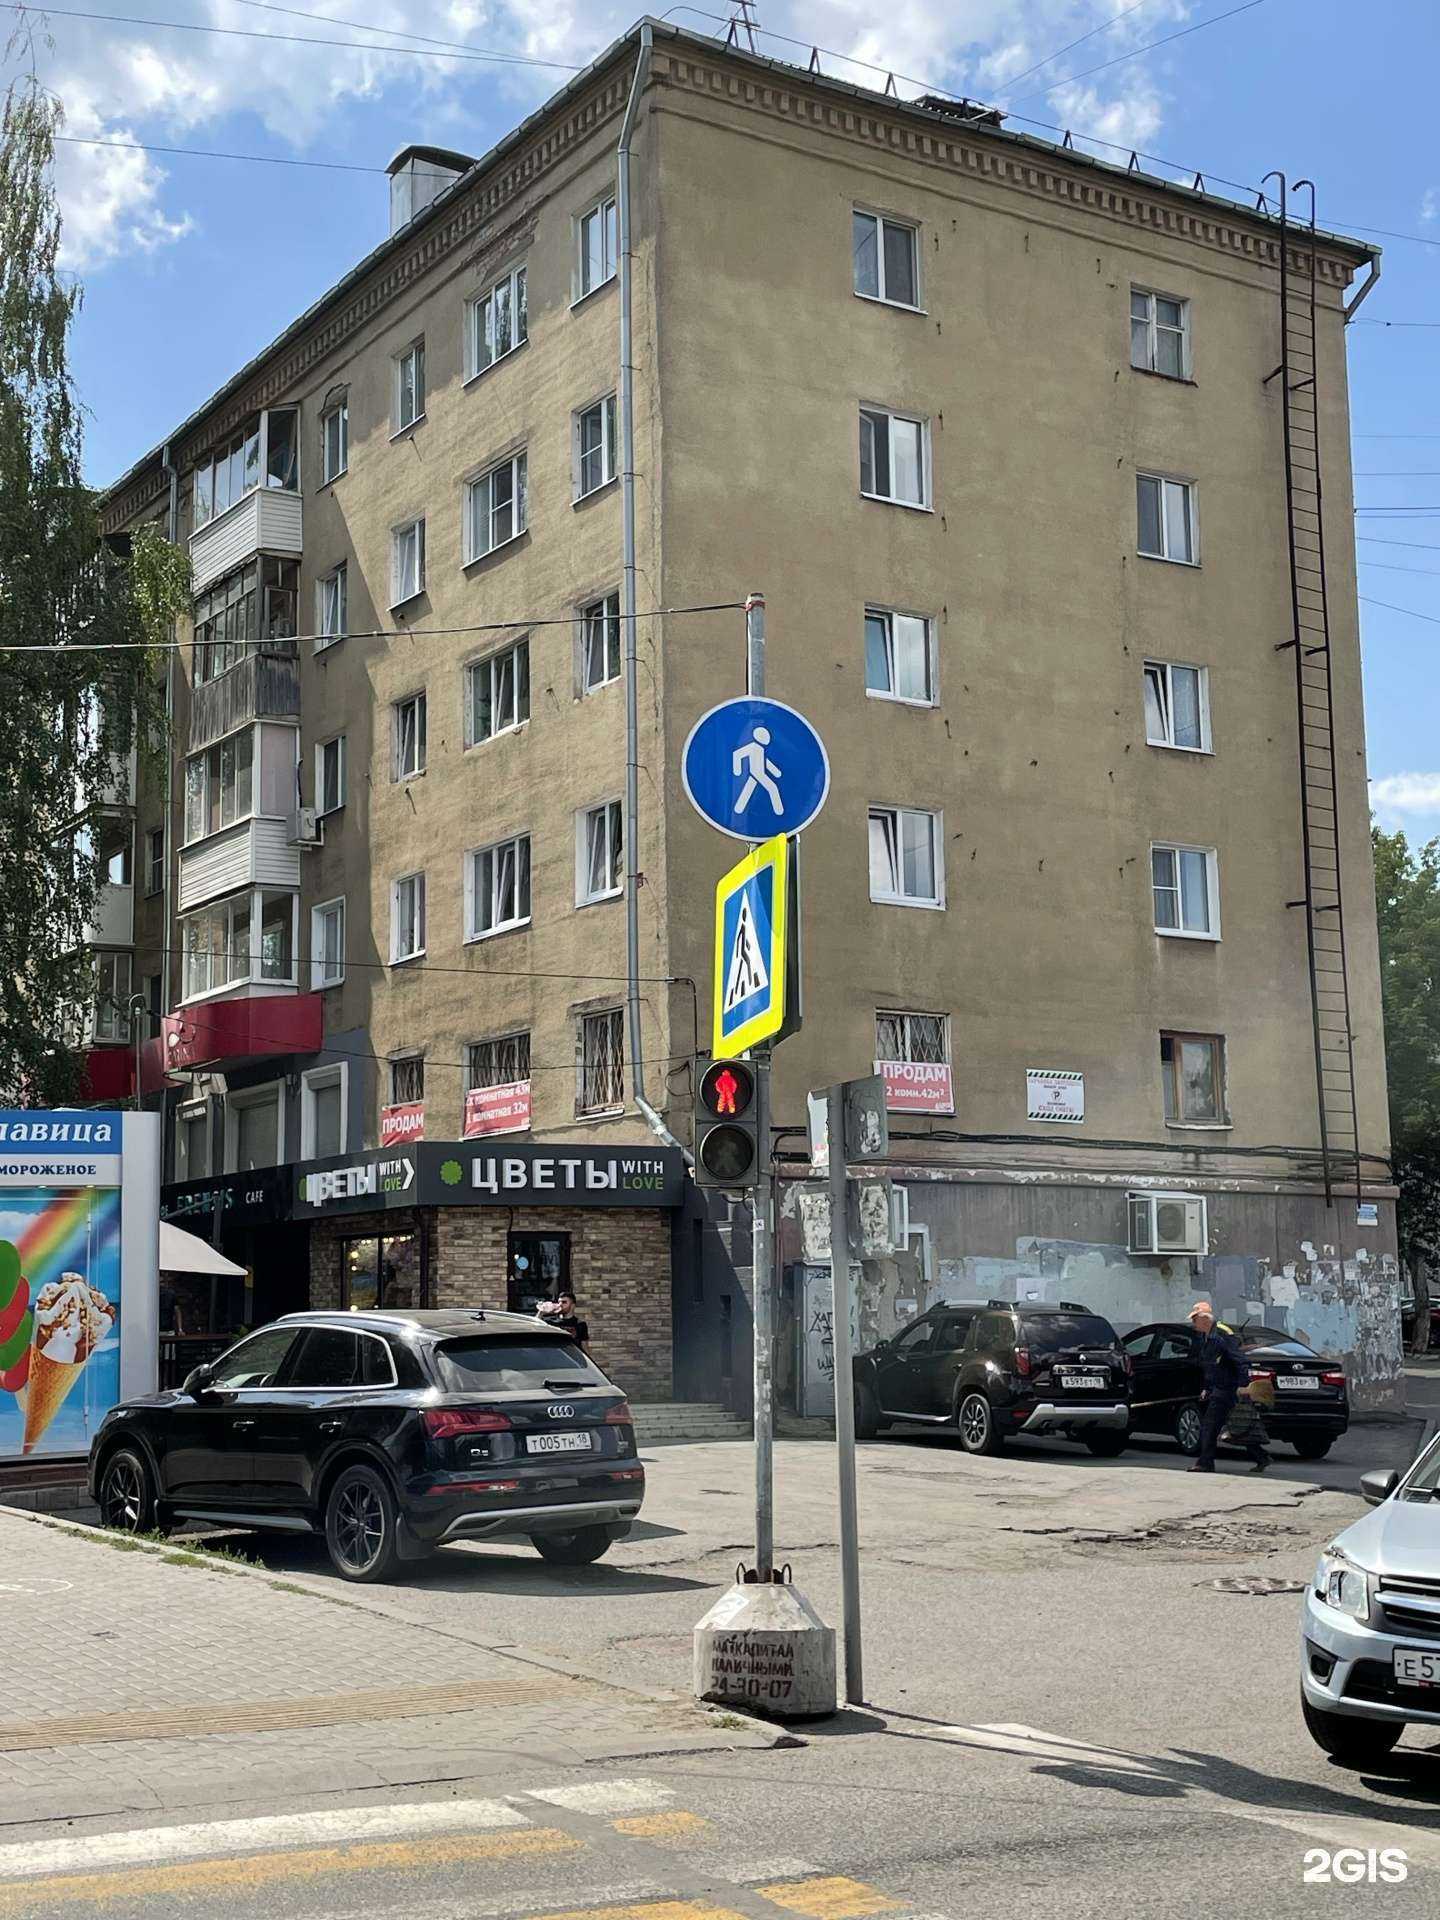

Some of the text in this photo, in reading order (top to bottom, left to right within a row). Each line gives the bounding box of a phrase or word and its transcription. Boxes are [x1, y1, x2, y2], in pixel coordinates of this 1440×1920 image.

[883, 1064, 947, 1083] ПРОДАМ
[886, 1086, 893, 1097] 2
[382, 1113, 425, 1134] ПРОДАМ
[379, 1160, 402, 1177] WITH
[621, 1160, 664, 1174] WITH
[471, 1158, 618, 1194] ЦВЕТЫ
[622, 1176, 664, 1190] LOVE
[245, 1189, 264, 1205] CAFE
[1404, 1655, 1440, 1679] Е5
